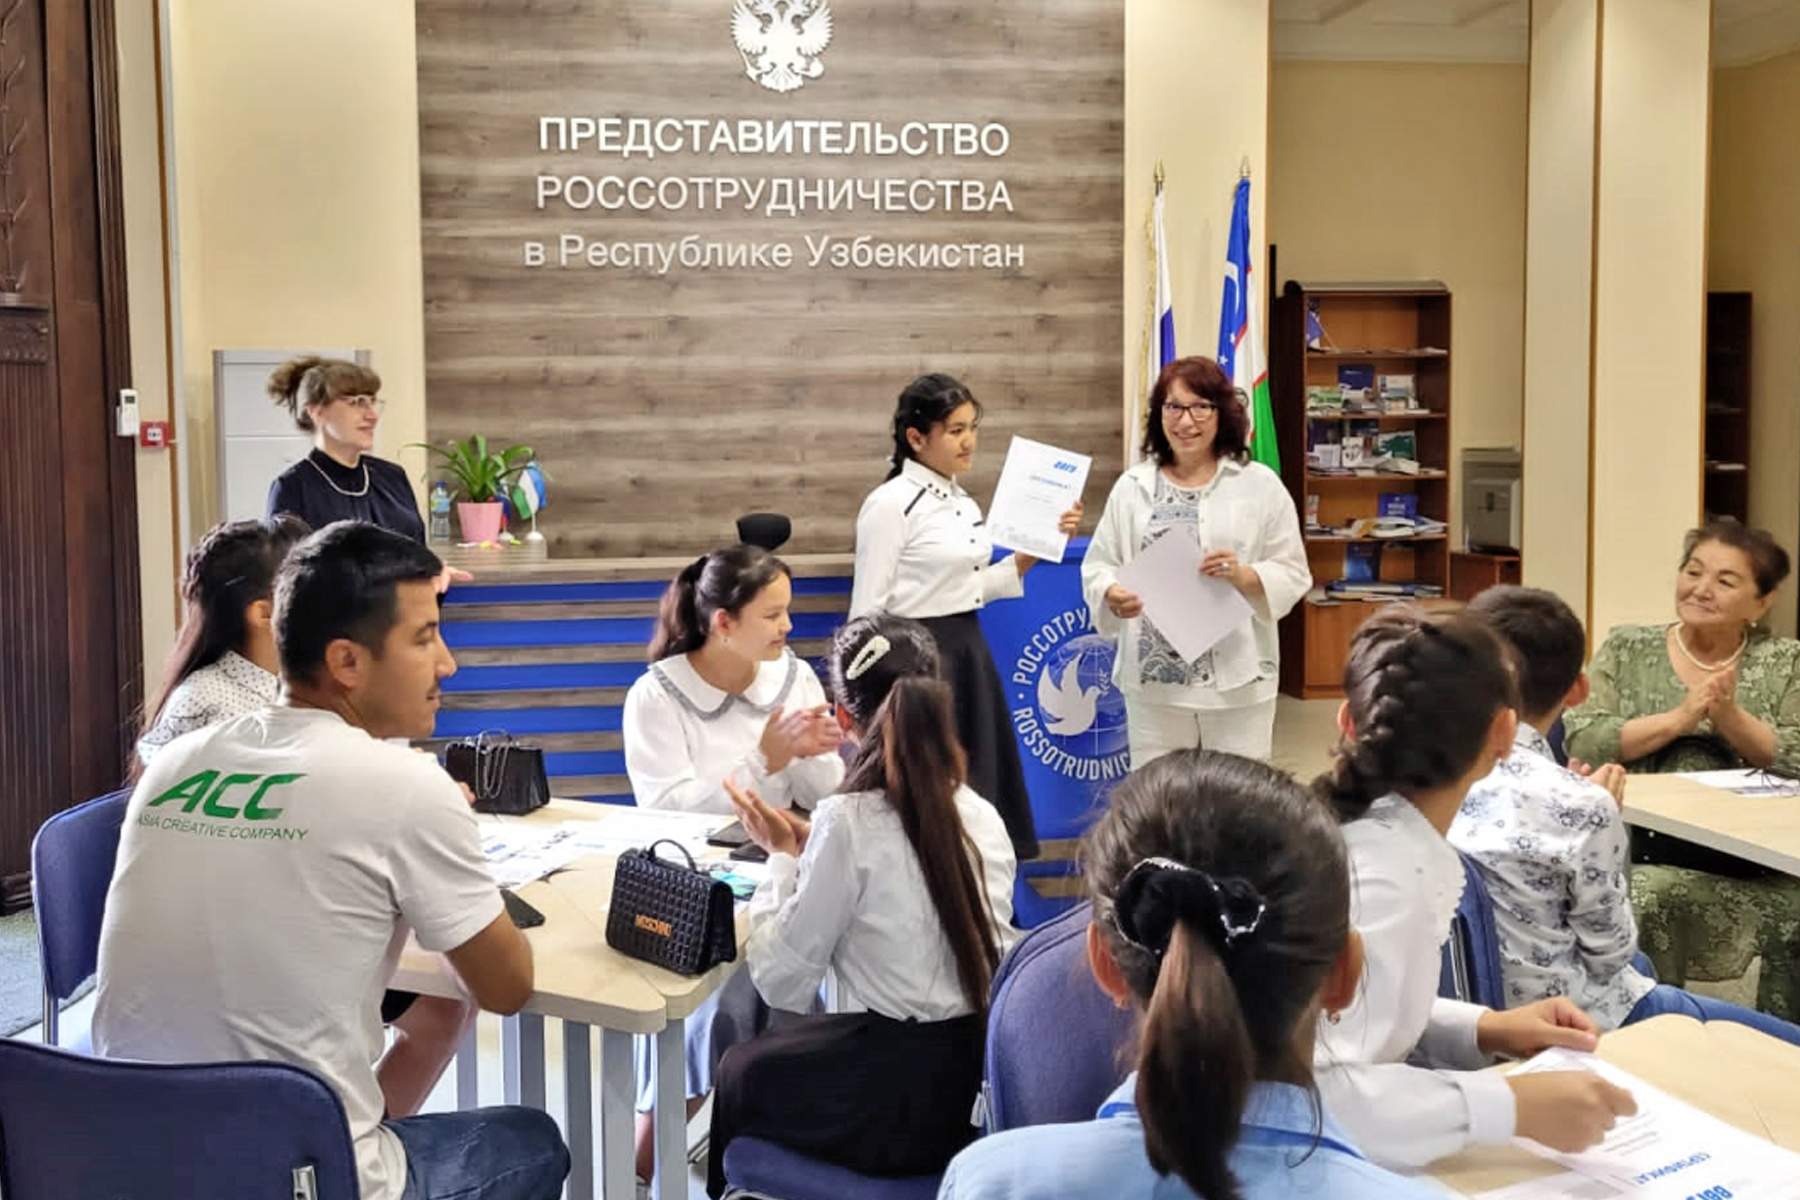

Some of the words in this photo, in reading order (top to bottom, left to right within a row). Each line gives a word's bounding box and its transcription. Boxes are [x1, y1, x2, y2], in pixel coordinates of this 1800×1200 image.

[539, 116, 1010, 157] ПРЕДСТАВИТЕЛЬСТВО
[536, 175, 1013, 216] РОССОТРУДНИЧЕСТВА
[523, 241, 546, 267] в
[559, 234, 794, 274] Республике
[803, 235, 1024, 268] Узбекистан
[148, 769, 308, 819] ACC
[161, 818, 227, 838] CREATIVE
[228, 825, 309, 841] COMPANY
